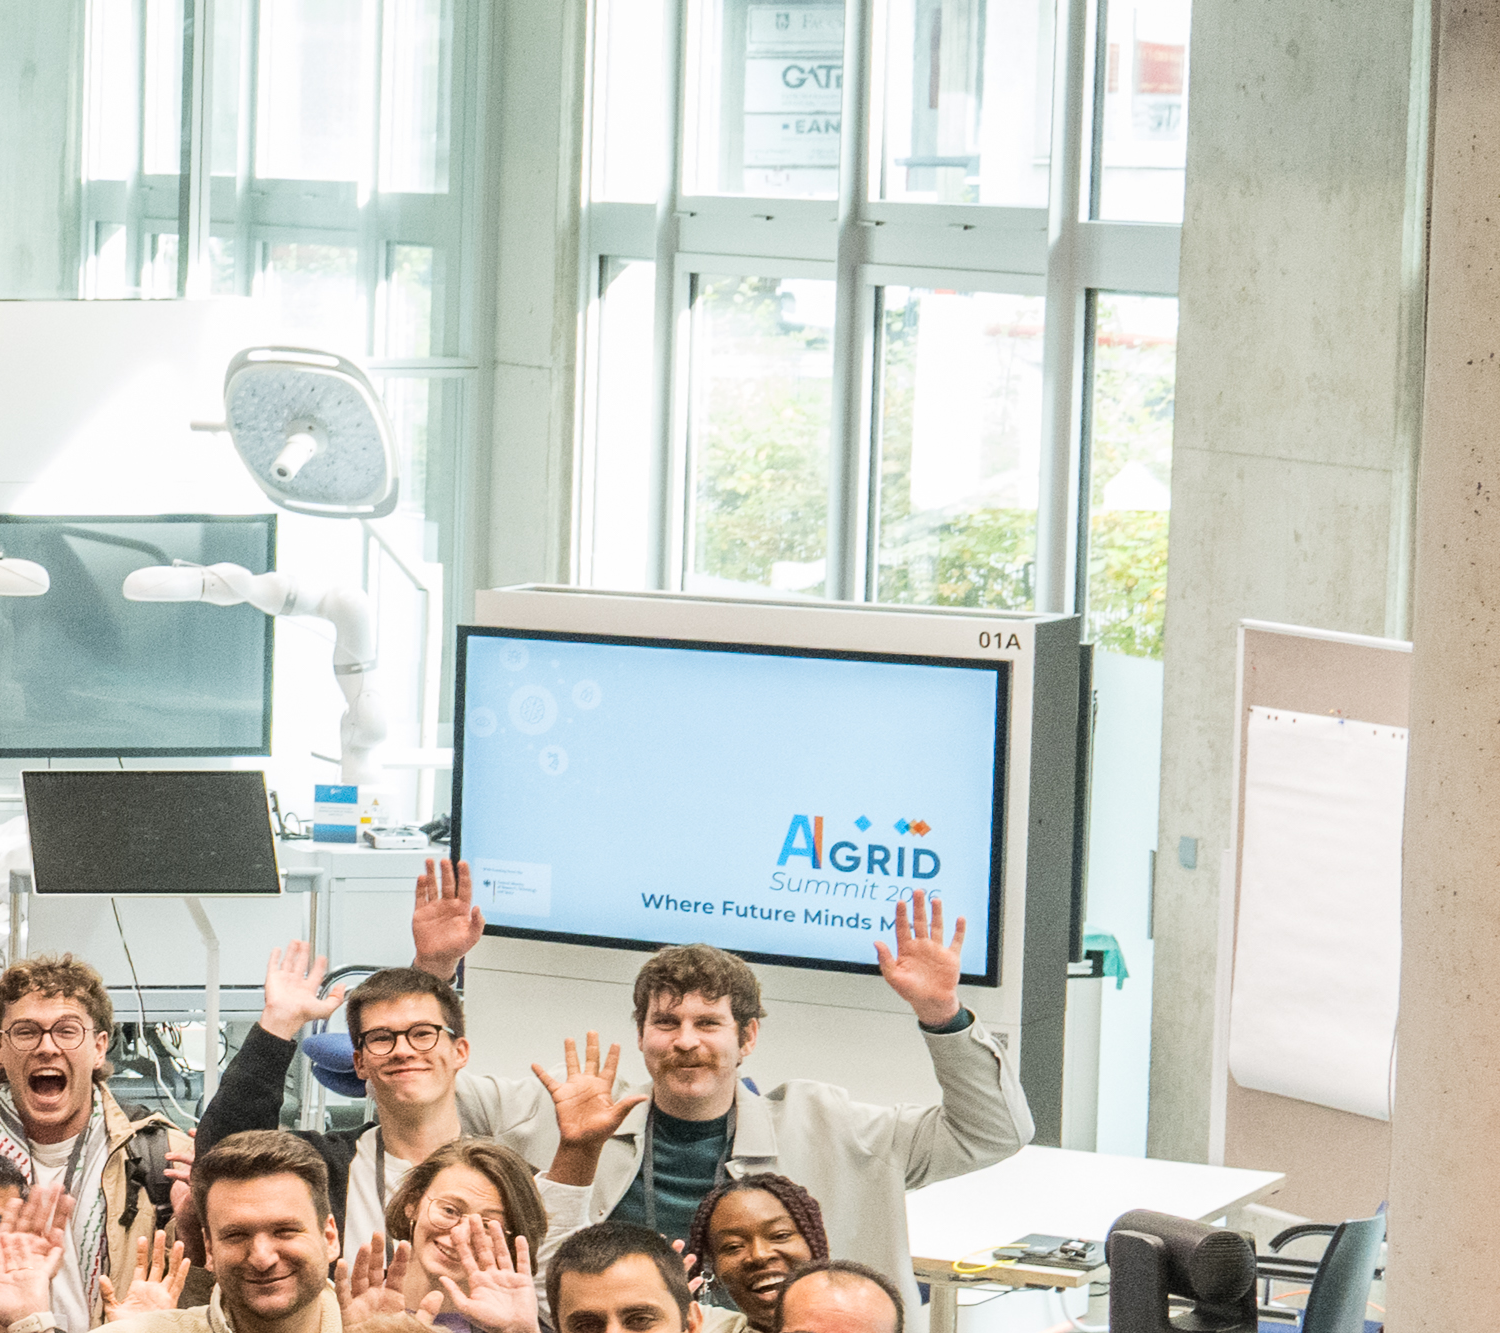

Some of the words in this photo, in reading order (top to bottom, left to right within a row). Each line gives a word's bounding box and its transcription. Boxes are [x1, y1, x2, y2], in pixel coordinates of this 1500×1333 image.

[978, 631, 1021, 651] 01A
[769, 871, 879, 901] Summit
[885, 885, 942, 903] 206
[641, 892, 715, 914] Where
[722, 900, 796, 922] Future
[804, 908, 872, 930] Minds
